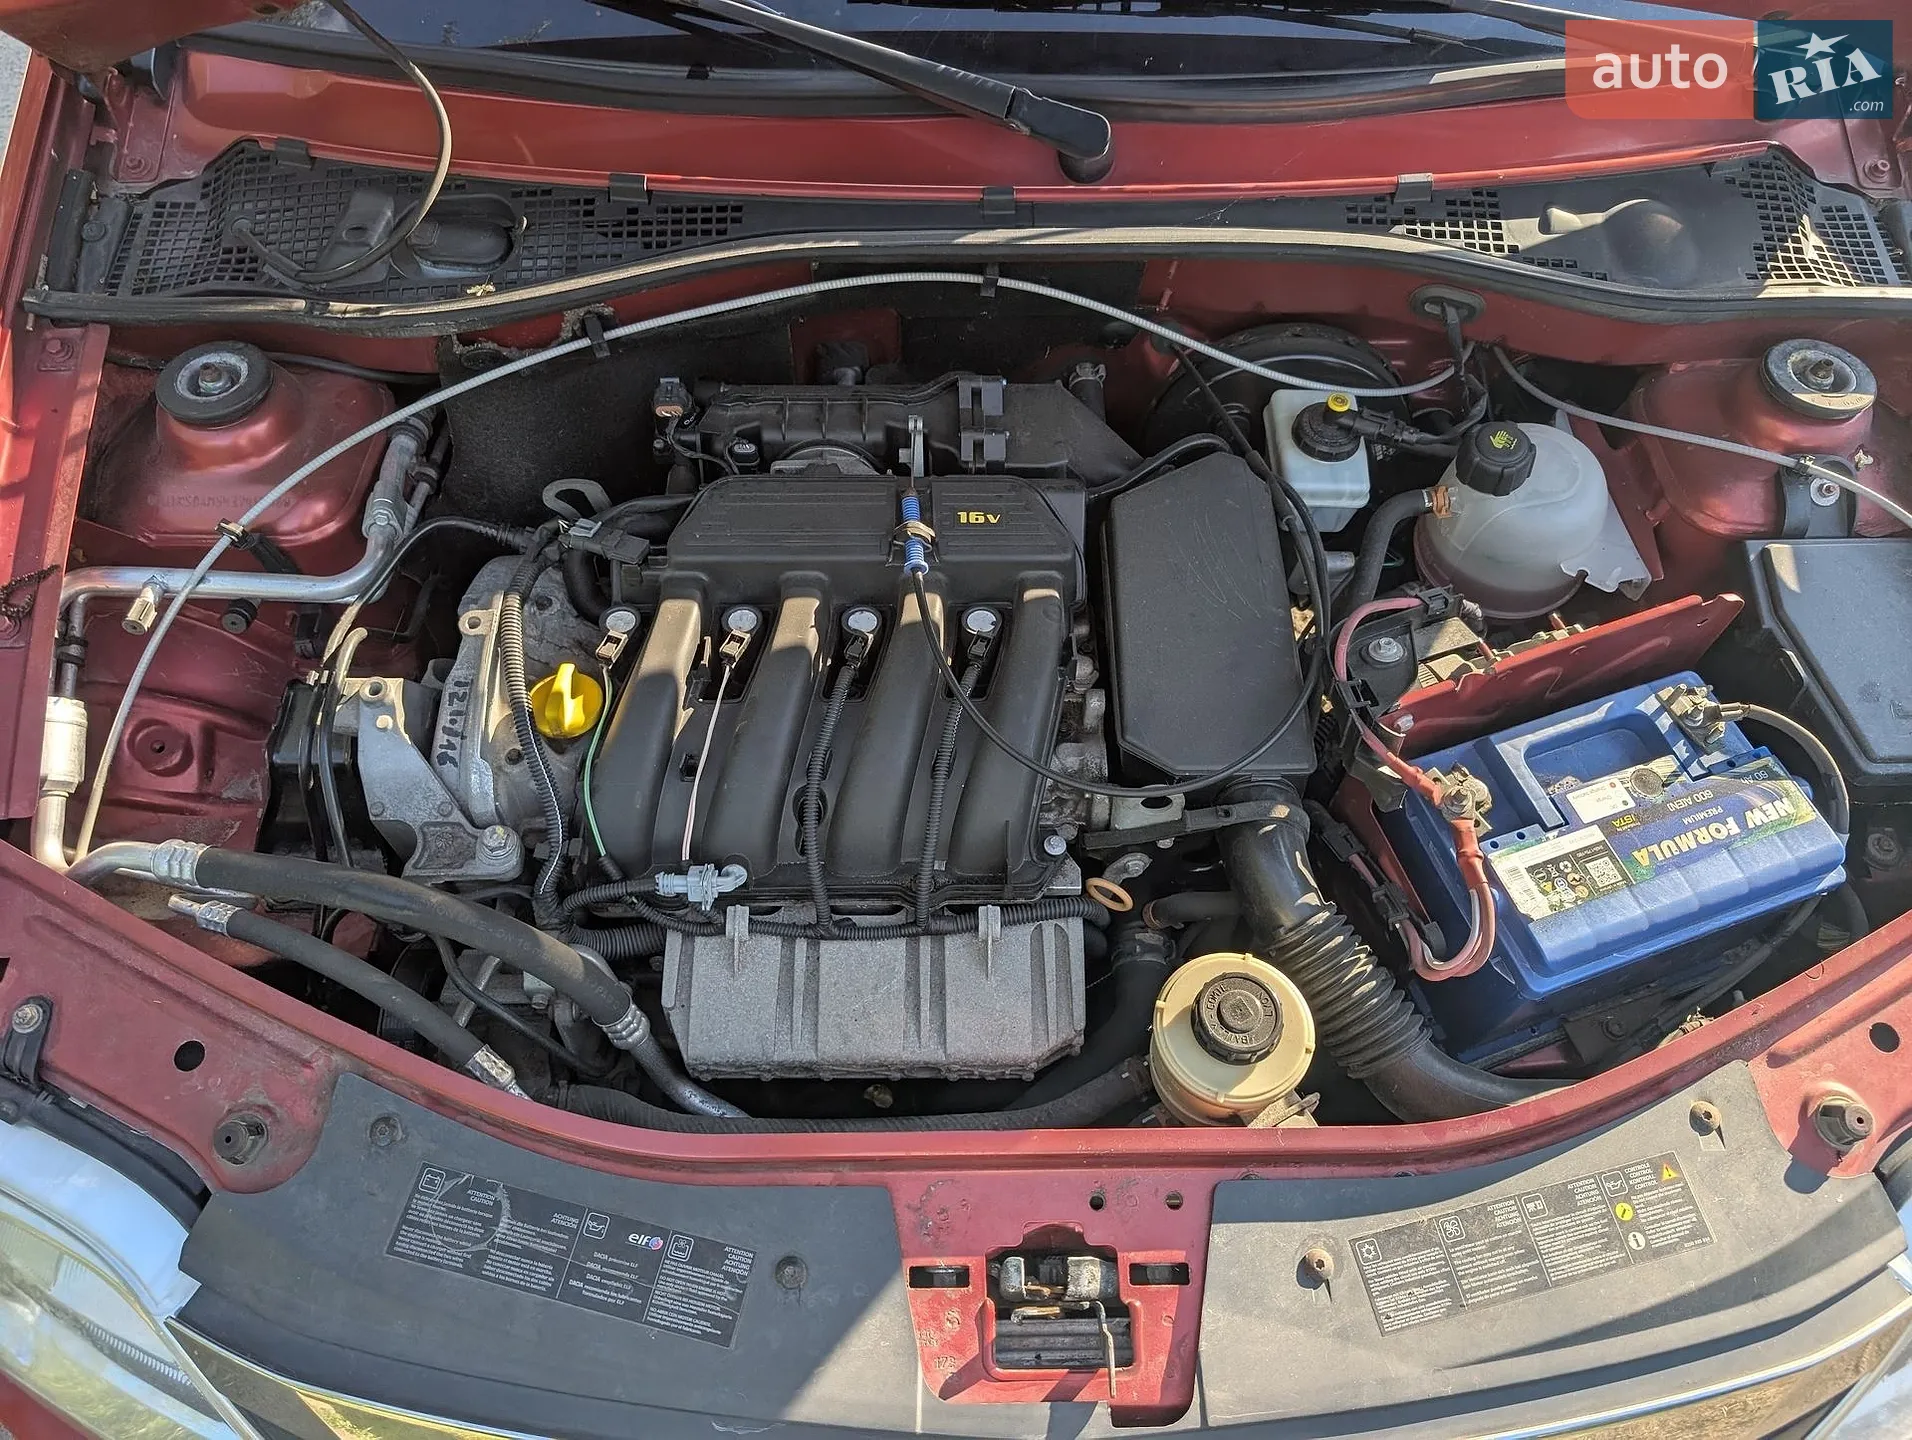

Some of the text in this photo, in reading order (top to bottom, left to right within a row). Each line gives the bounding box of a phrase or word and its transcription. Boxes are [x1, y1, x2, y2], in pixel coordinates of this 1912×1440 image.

[1691, 788, 1713, 803] 600
[1612, 813, 1636, 827] ISTA
[1682, 805, 1723, 825] PREMIUM
[1632, 797, 1796, 866] NEW FORMULA
[467, 1189, 496, 1201] ATTENTION
[470, 1196, 494, 1206] CAUTION
[628, 1233, 652, 1246] elf
[724, 1246, 754, 1258] ATTENTION
[728, 1253, 752, 1264] CAUTION
